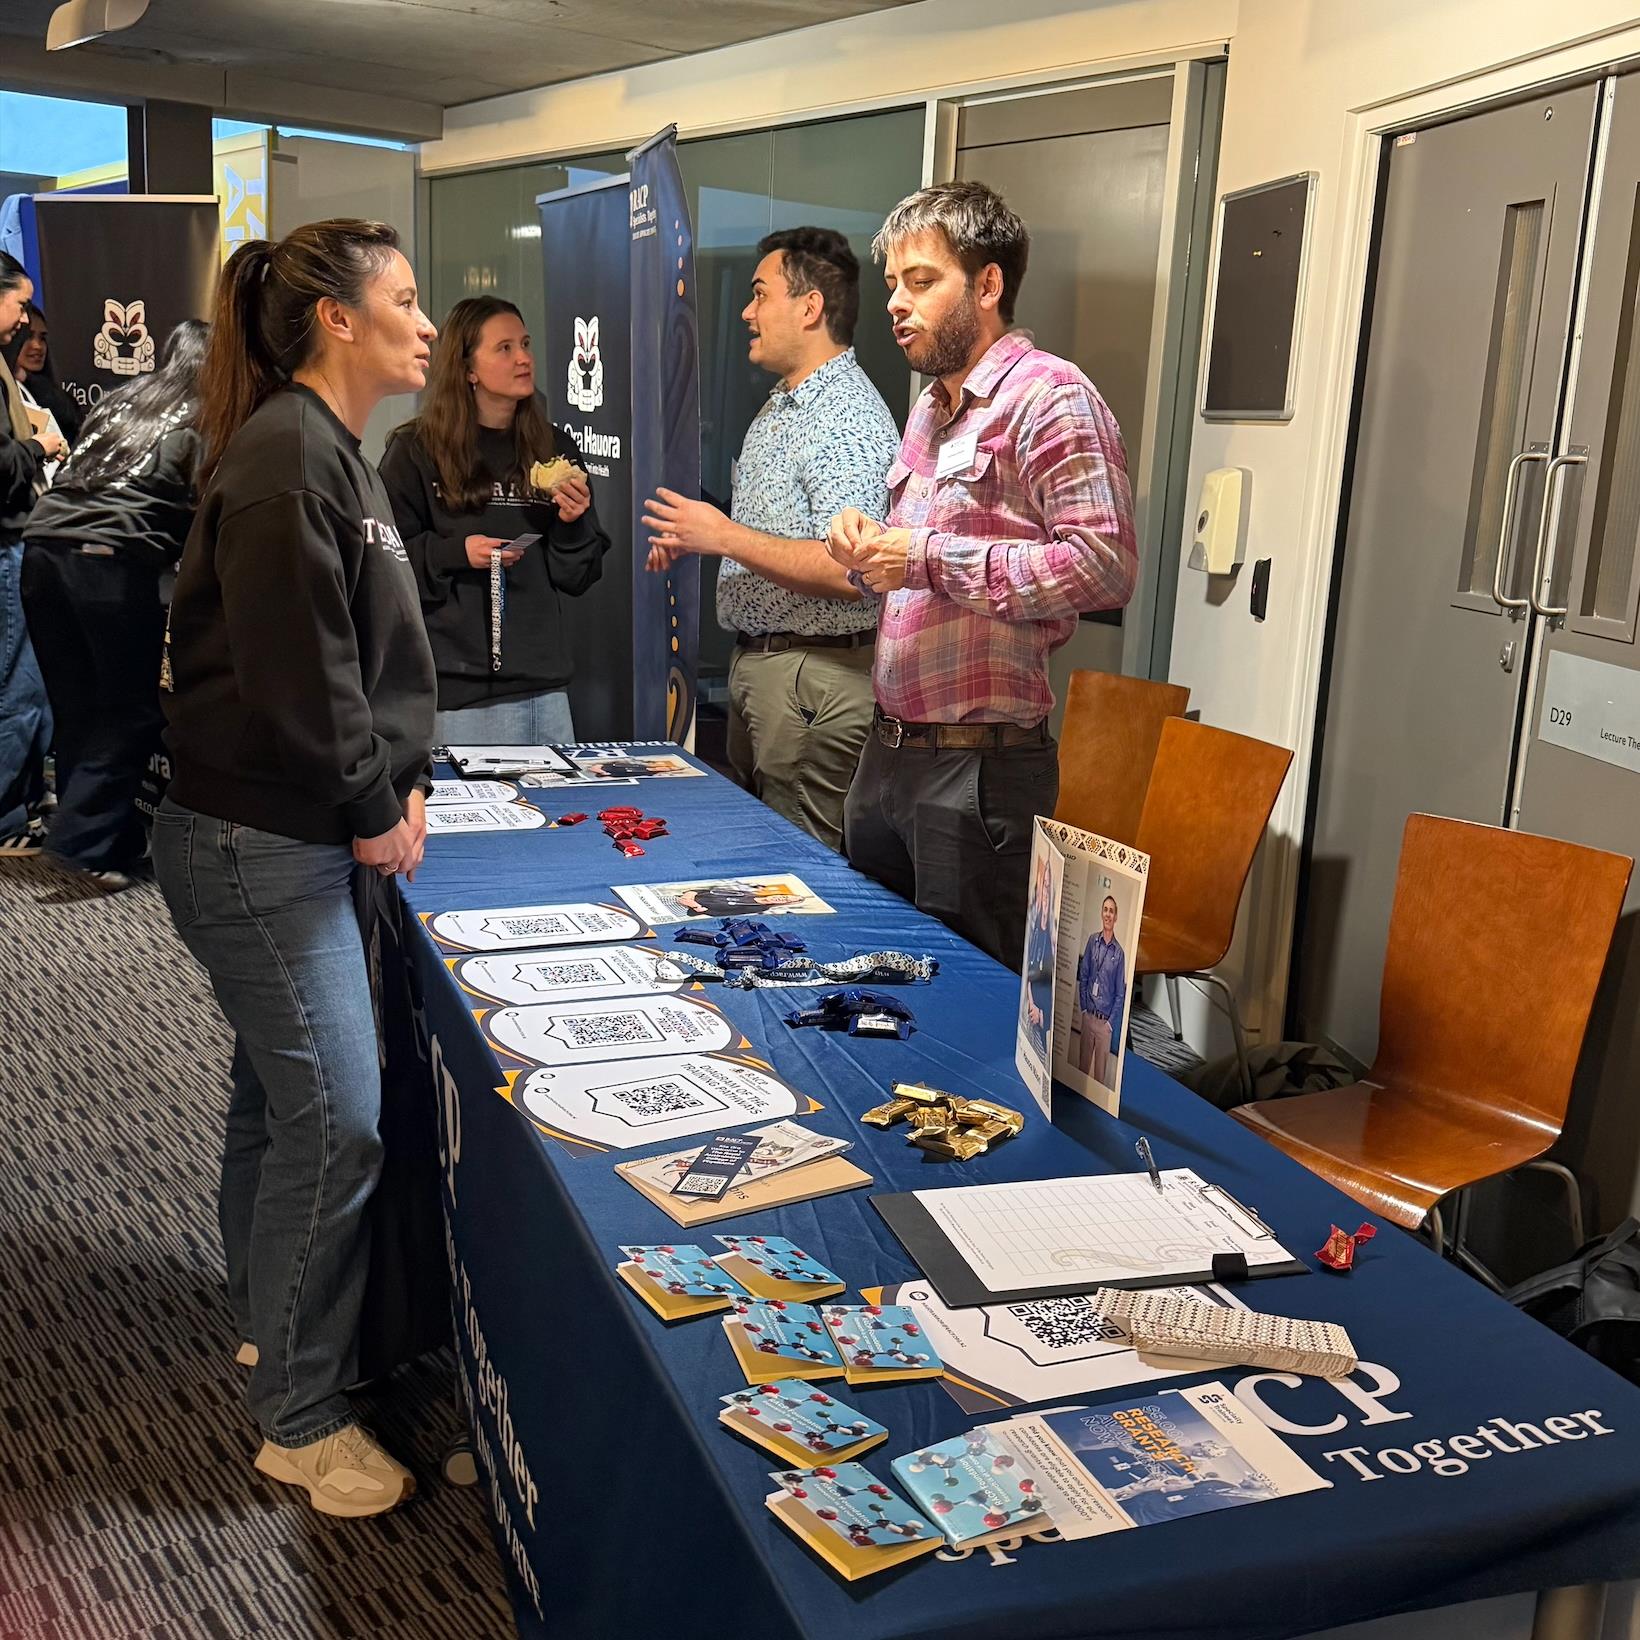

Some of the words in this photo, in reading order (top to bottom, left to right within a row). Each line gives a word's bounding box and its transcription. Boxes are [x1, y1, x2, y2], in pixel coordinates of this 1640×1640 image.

[584, 425, 621, 459] Hauora
[1549, 706, 1572, 727] D29
[1600, 727, 1627, 747] Lecture
[681, 1062, 721, 1091] TRAINING
[717, 1086, 763, 1115] PATHWAYS
[700, 1064, 742, 1091] DIAGRAM
[748, 1094, 770, 1109] THE
[1174, 1287, 1203, 1304] RAC
[460, 1260, 539, 1532] Together
[1220, 1403, 1244, 1424] Specialty
[1233, 1360, 1414, 1437] CP
[1079, 1415, 1117, 1444] NOW
[1111, 1410, 1169, 1461] GRANTS
[1126, 1407, 1201, 1474] RESEARCH
[1323, 1408, 1615, 1483] Together
[960, 1459, 988, 1490] Foundation
[1009, 1429, 1029, 1450] research
[1025, 1449, 1042, 1468] grants
[1045, 1470, 1058, 1484] value
[1019, 1427, 1043, 1454] candidates
[1048, 1460, 1065, 1479] eligible
[1066, 1481, 1082, 1499] apply
[984, 1489, 1003, 1506] RACP
[1044, 1442, 1057, 1457] know
[1055, 1455, 1068, 1468] that
[1064, 1465, 1075, 1478] you
[1072, 1475, 1083, 1487] and
[1080, 1485, 1094, 1500] your
[1092, 1497, 1113, 1520] research
[837, 1496, 874, 1526] Foundation
